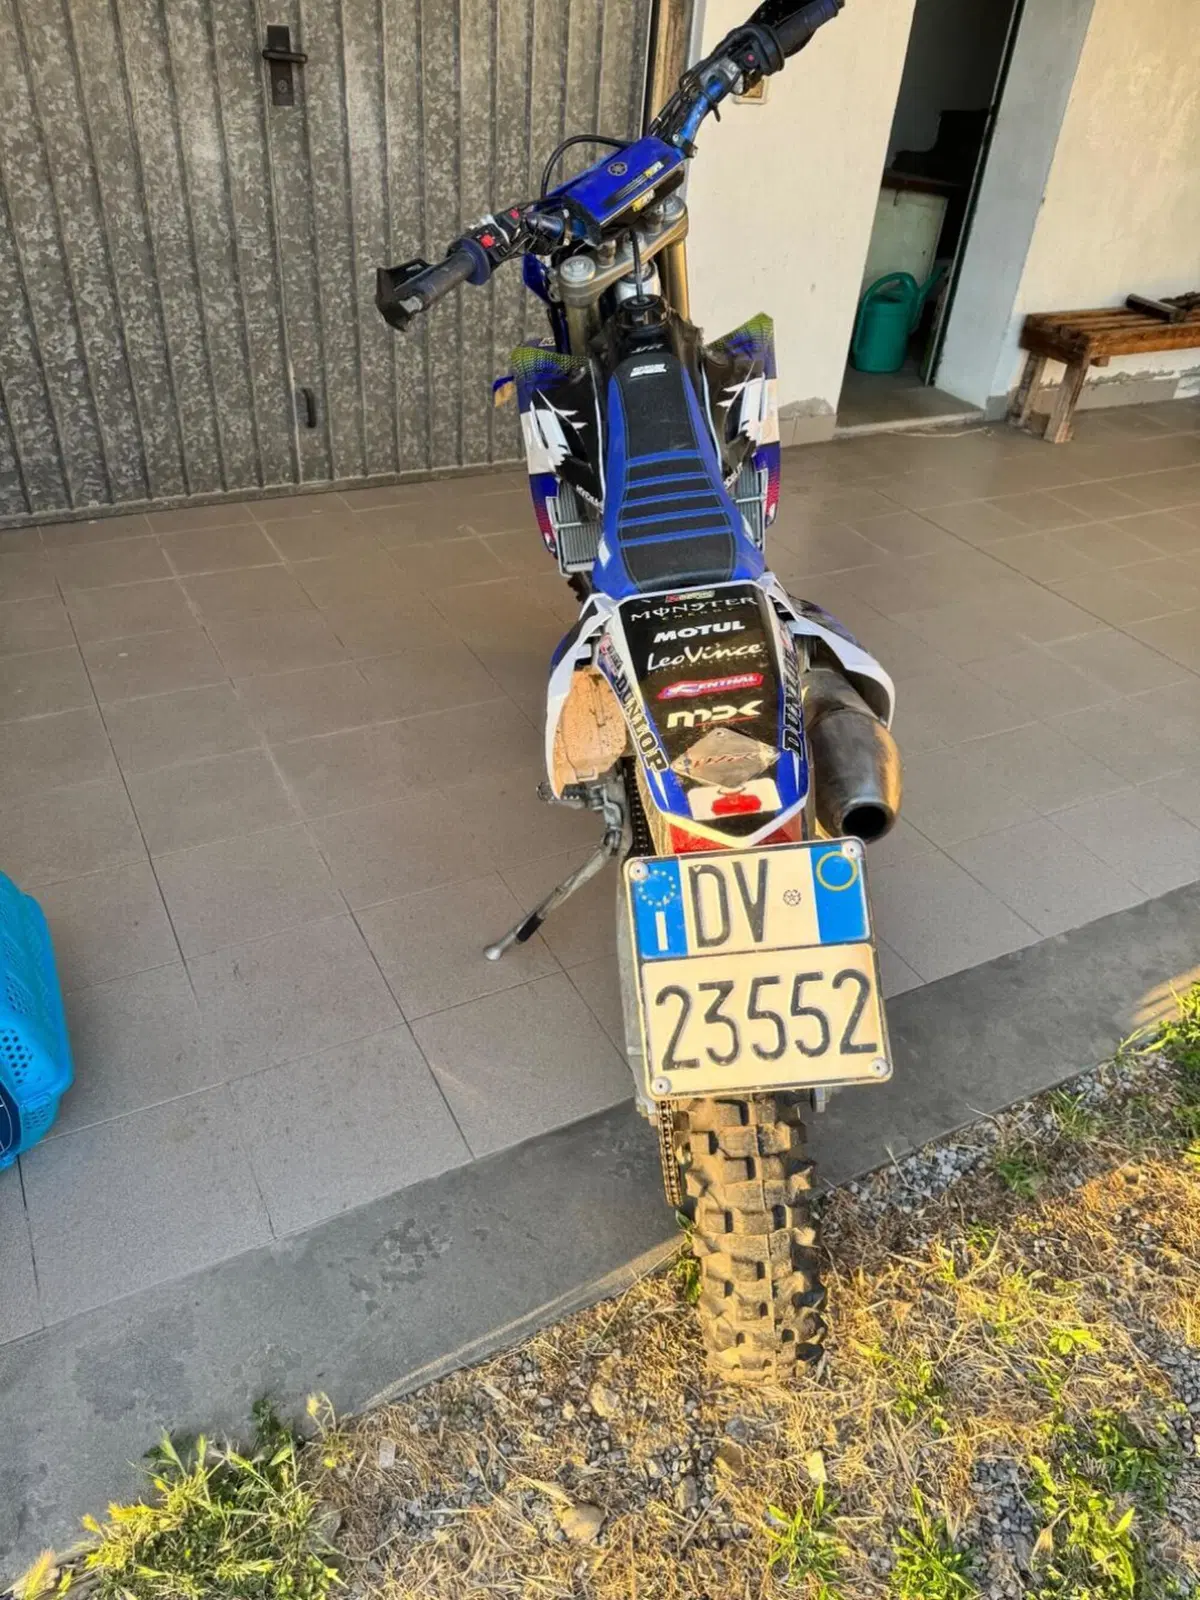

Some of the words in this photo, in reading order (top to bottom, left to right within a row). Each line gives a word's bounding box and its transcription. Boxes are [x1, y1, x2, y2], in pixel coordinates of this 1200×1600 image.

[631, 596, 758, 622] MONSTER
[653, 620, 746, 644] MOTUL
[647, 643, 763, 671] LeoVince
[614, 672, 669, 772] DUNLOP
[688, 858, 769, 948] DV
[655, 967, 878, 1072] 23552
